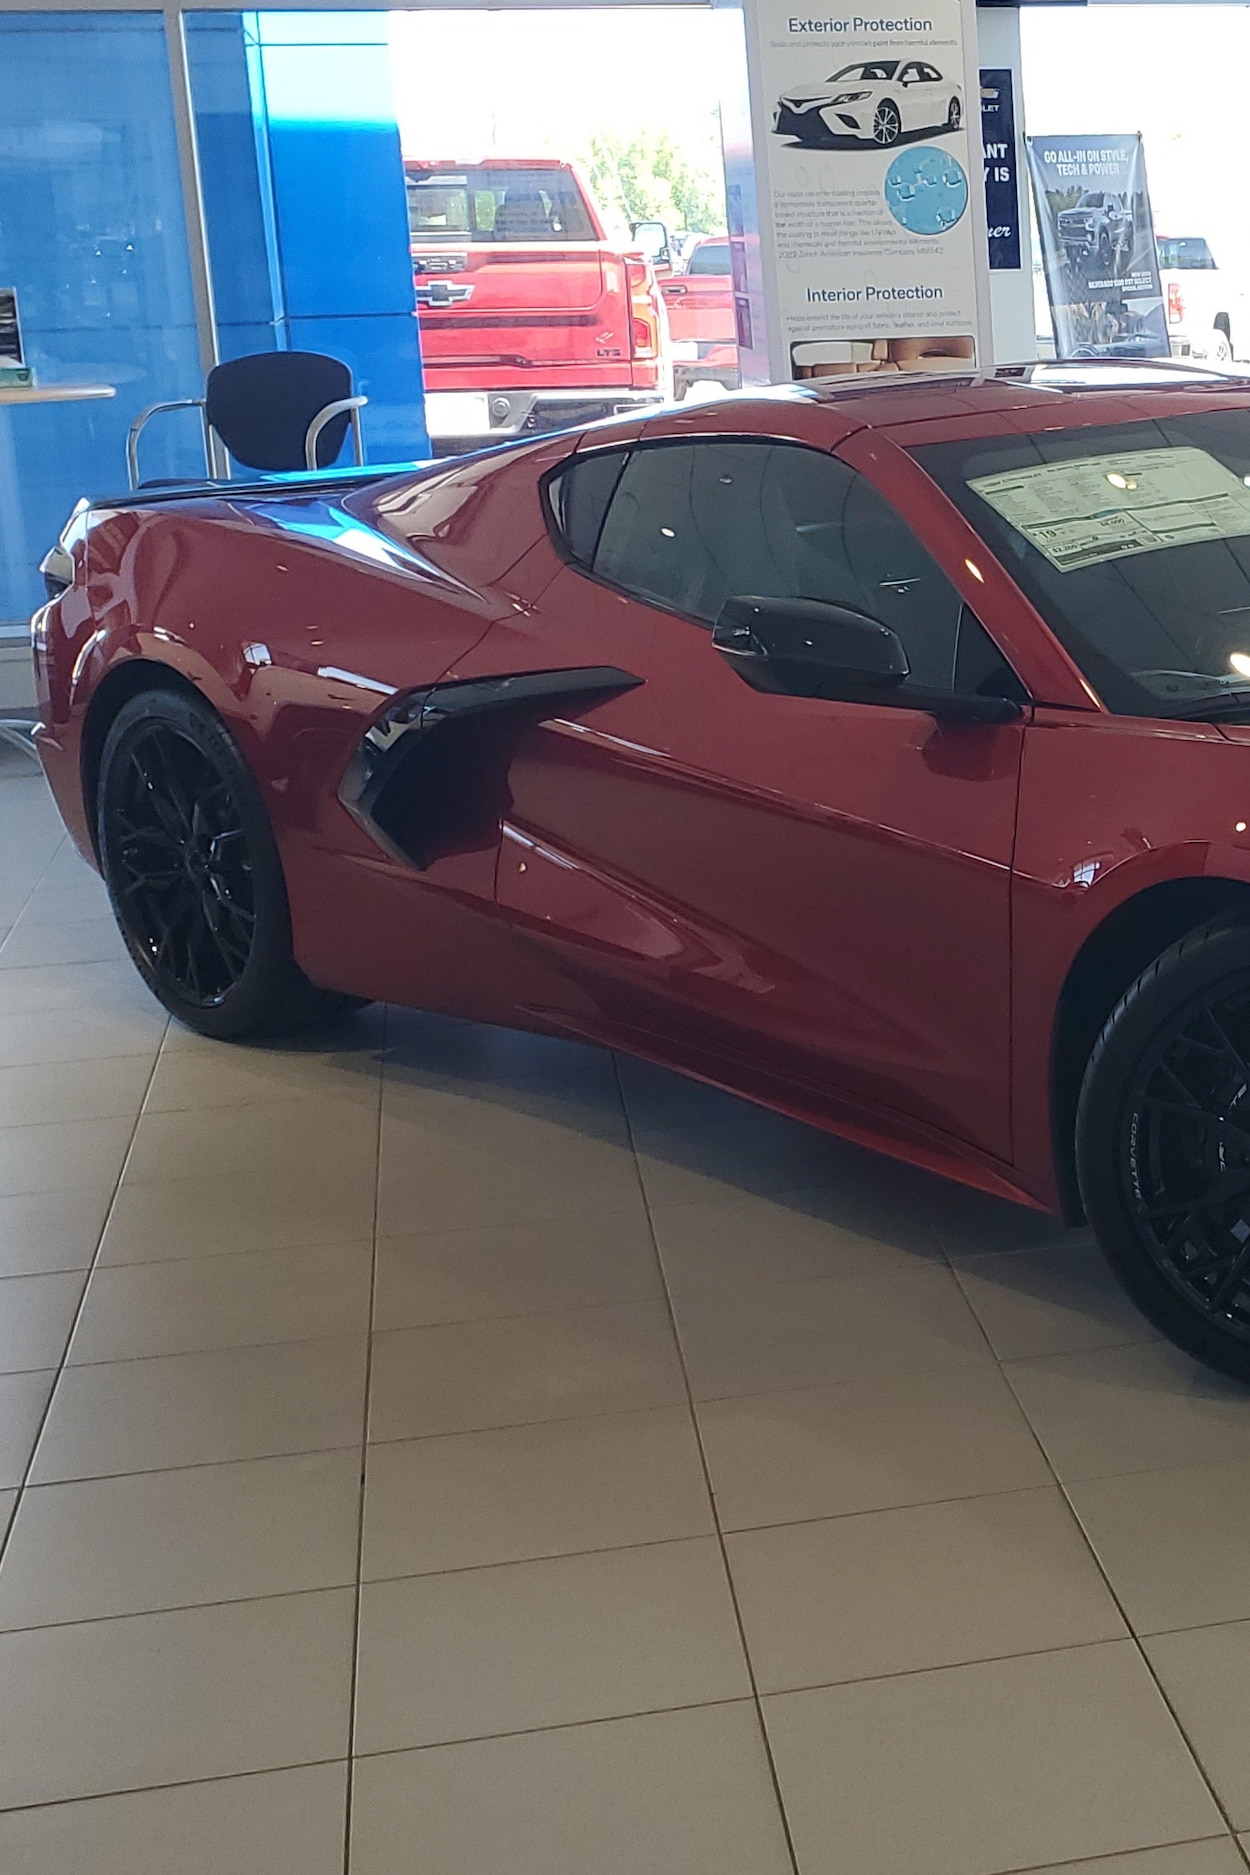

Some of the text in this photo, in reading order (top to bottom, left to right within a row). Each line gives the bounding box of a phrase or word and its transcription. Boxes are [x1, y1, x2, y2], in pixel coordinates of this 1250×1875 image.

[789, 16, 933, 33] Exterior Protection
[1044, 150, 1057, 163] GO
[1087, 150, 1099, 162] ON
[1100, 149, 1129, 163] STYLE,
[994, 167, 1010, 182] IS
[1056, 163, 1120, 176] TECH & POWER
[807, 285, 943, 303] Interior Protection
[1130, 1112, 1143, 1200] CORVETTE
